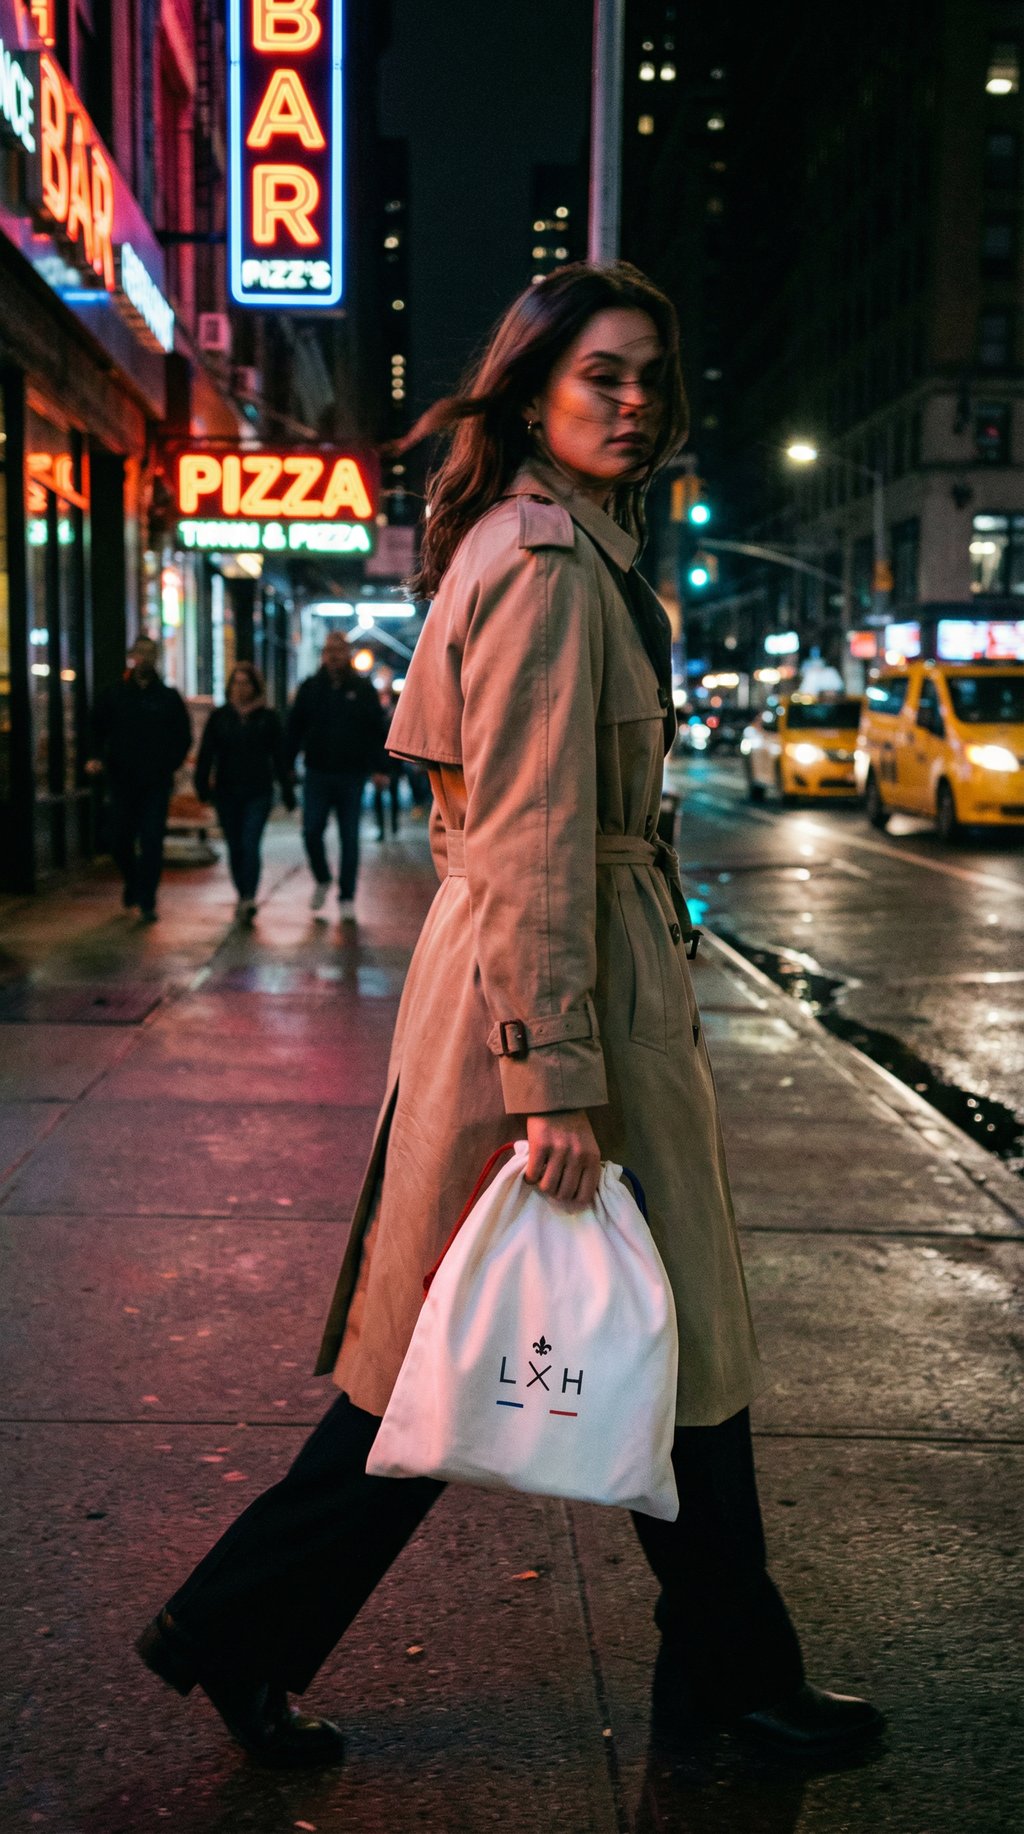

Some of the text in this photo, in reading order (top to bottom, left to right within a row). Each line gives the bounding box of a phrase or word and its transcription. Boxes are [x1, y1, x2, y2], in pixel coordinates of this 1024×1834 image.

[40, 54, 115, 291] BAR
[246, 0, 326, 245] BAR
[179, 455, 372, 518] PIZZA
[262, 522, 286, 549] &
[289, 523, 370, 552] PIZZA
